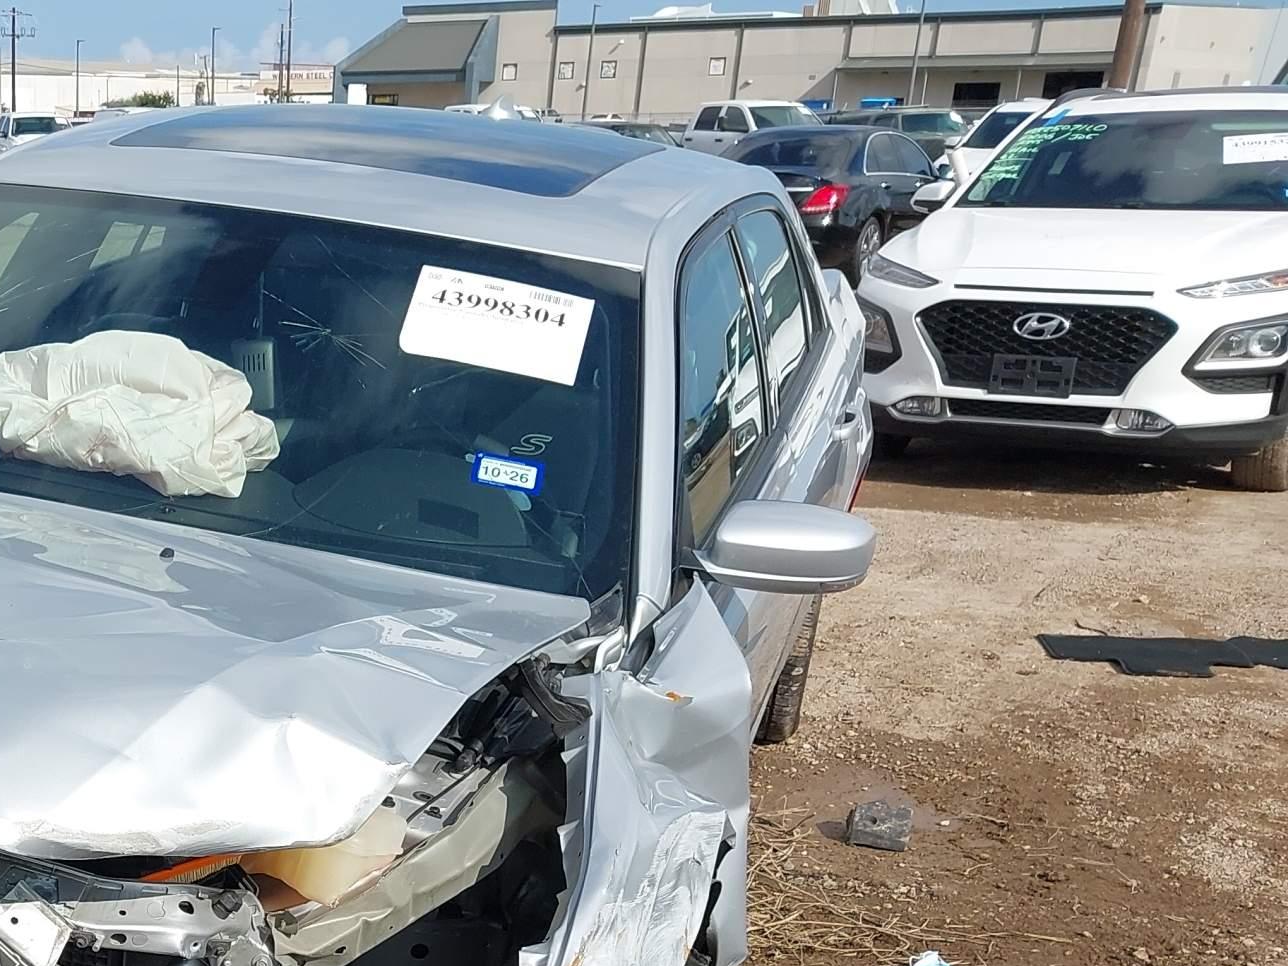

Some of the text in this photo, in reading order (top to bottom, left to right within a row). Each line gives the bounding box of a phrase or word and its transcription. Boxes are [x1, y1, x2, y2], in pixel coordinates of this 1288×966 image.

[306, 72, 327, 80] STEEL
[431, 289, 566, 327] 43998304
[482, 466, 529, 483] 10 26
